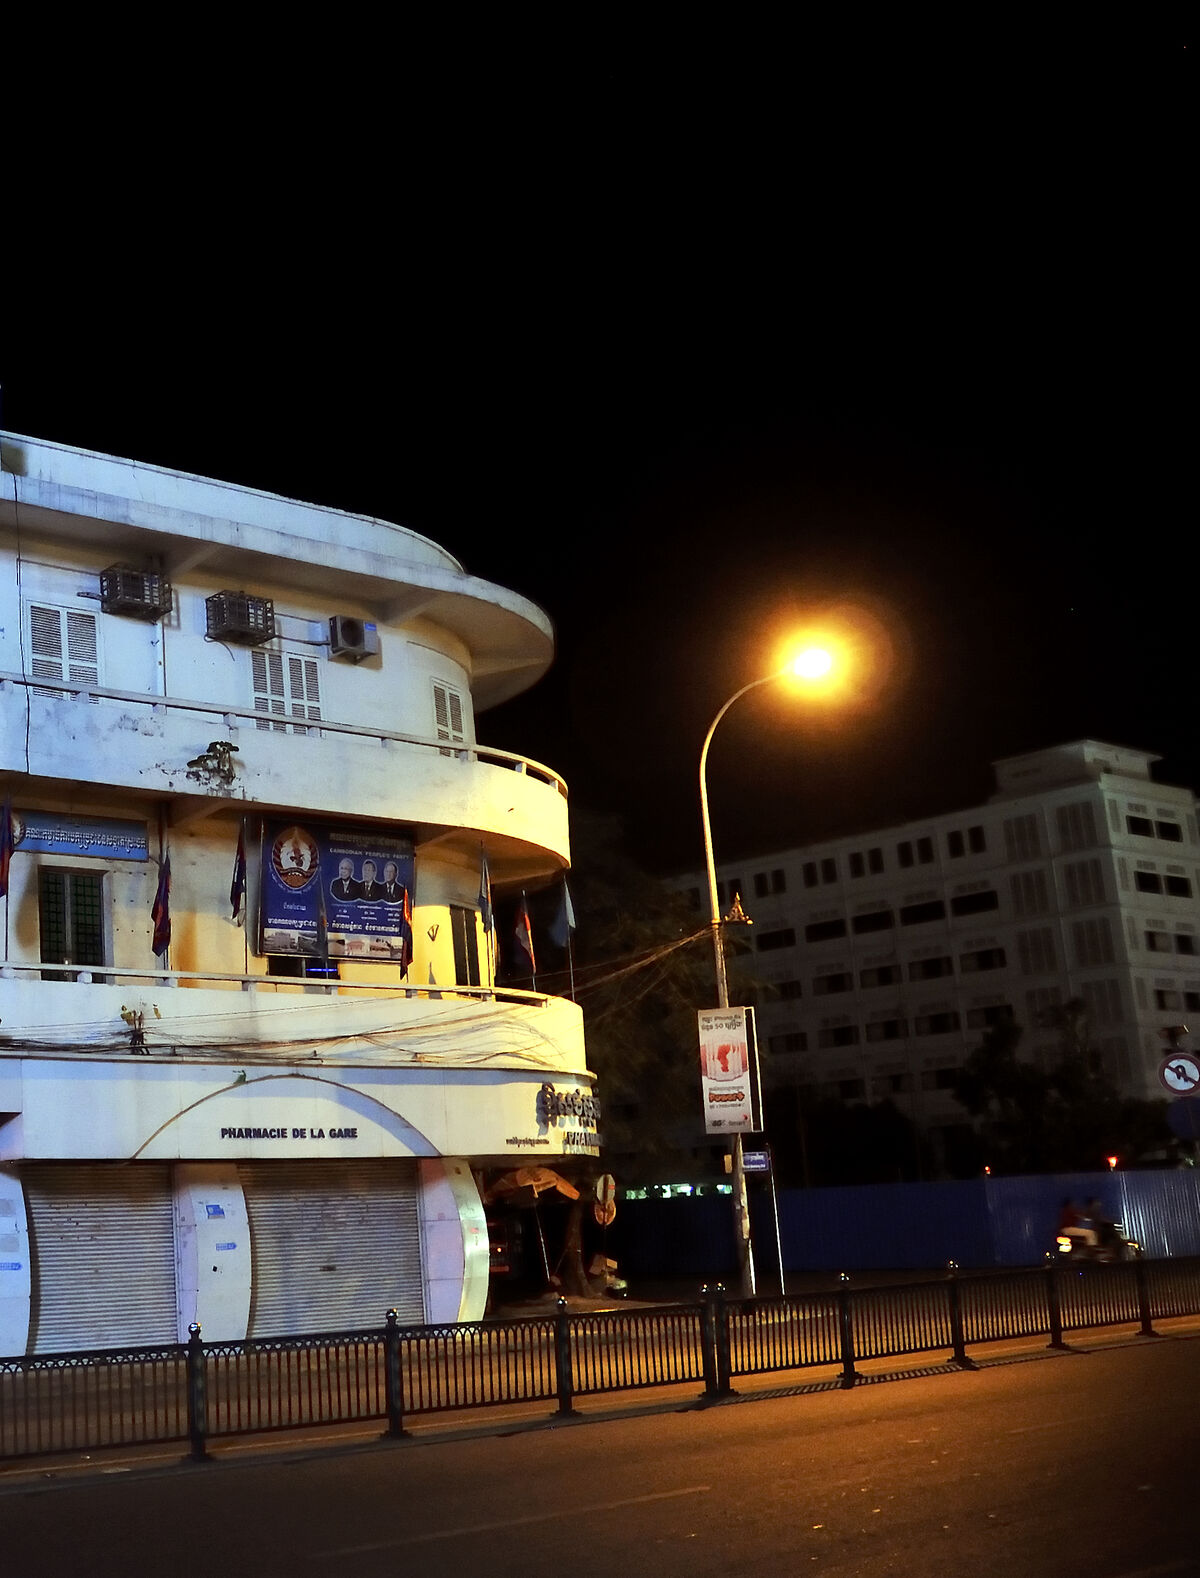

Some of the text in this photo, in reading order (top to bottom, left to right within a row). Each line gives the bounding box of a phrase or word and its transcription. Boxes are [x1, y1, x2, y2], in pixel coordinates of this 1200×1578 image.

[329, 847, 363, 856] CAMBODIAN
[220, 1127, 358, 1139] PHARMACIE DE LA GARE
